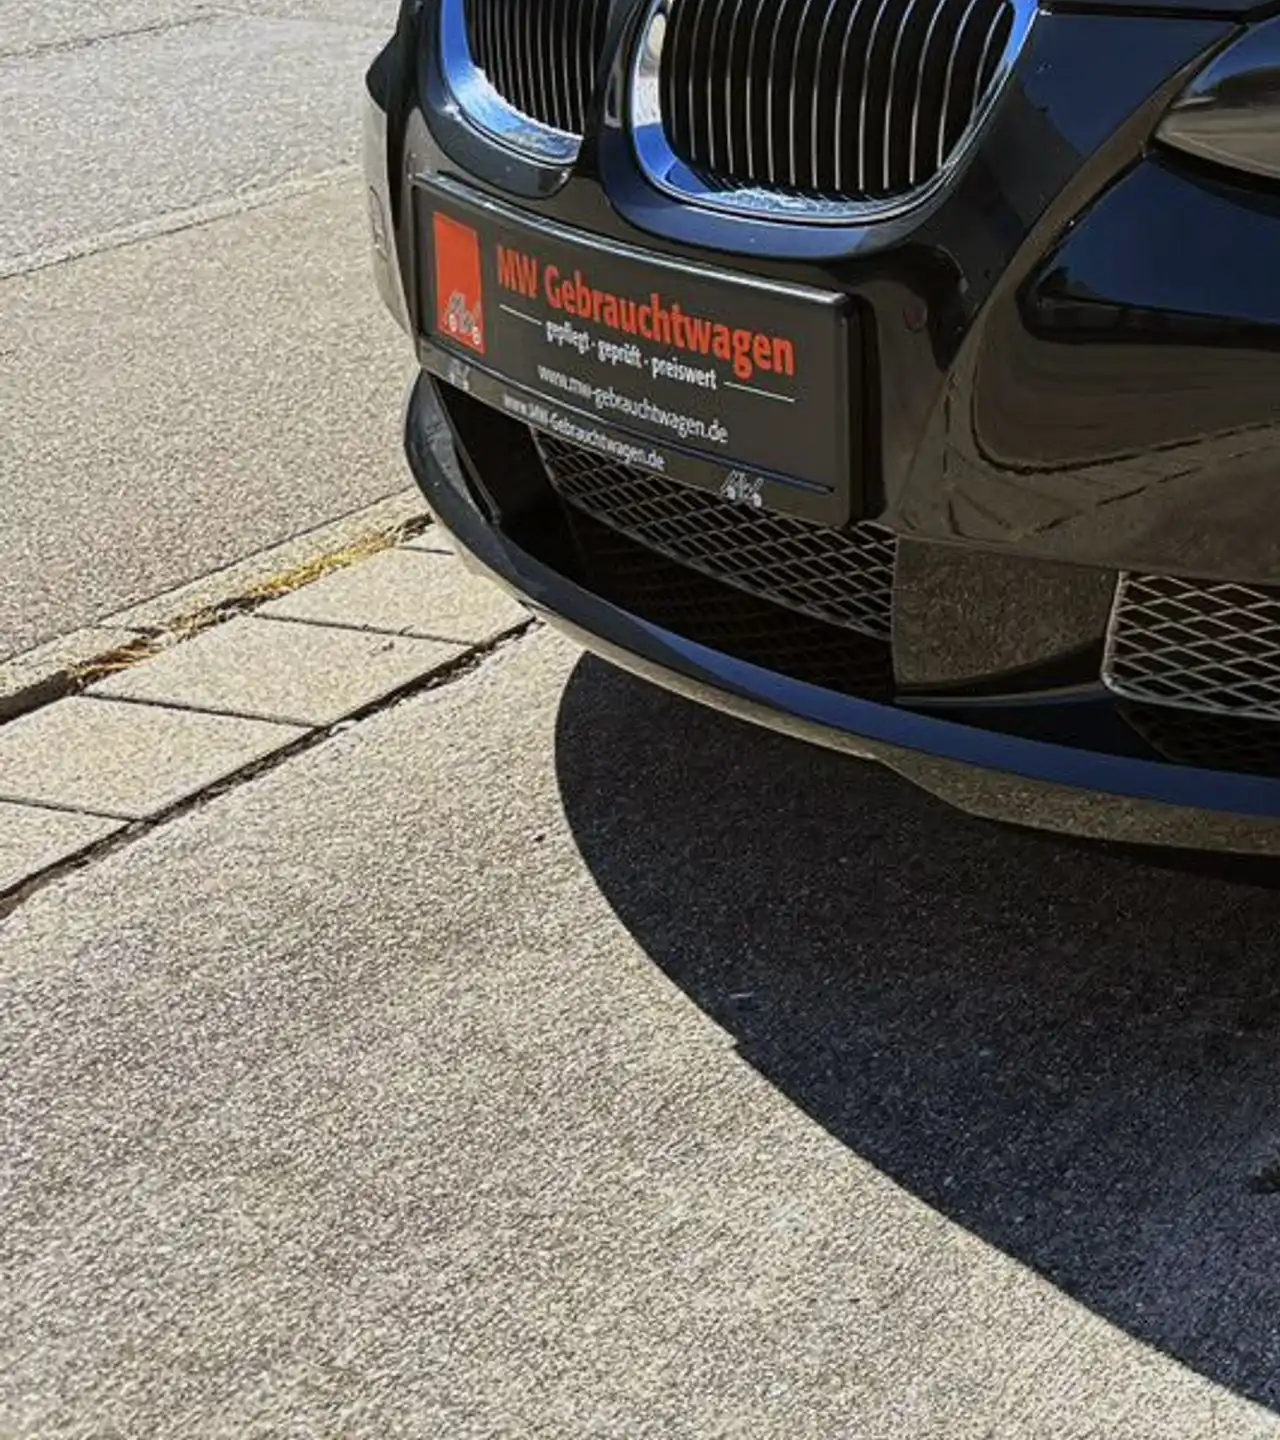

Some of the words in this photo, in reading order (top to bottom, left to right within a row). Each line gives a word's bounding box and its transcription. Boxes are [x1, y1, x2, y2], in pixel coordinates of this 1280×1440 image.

[497, 246, 538, 299] MW
[545, 264, 795, 380] Gebrauchtwagen
[546, 320, 590, 355] gepflegt
[597, 339, 643, 369] geprüft
[651, 356, 717, 391] preiswert
[537, 364, 729, 444] www.mw-gebrauchtwagen.de
